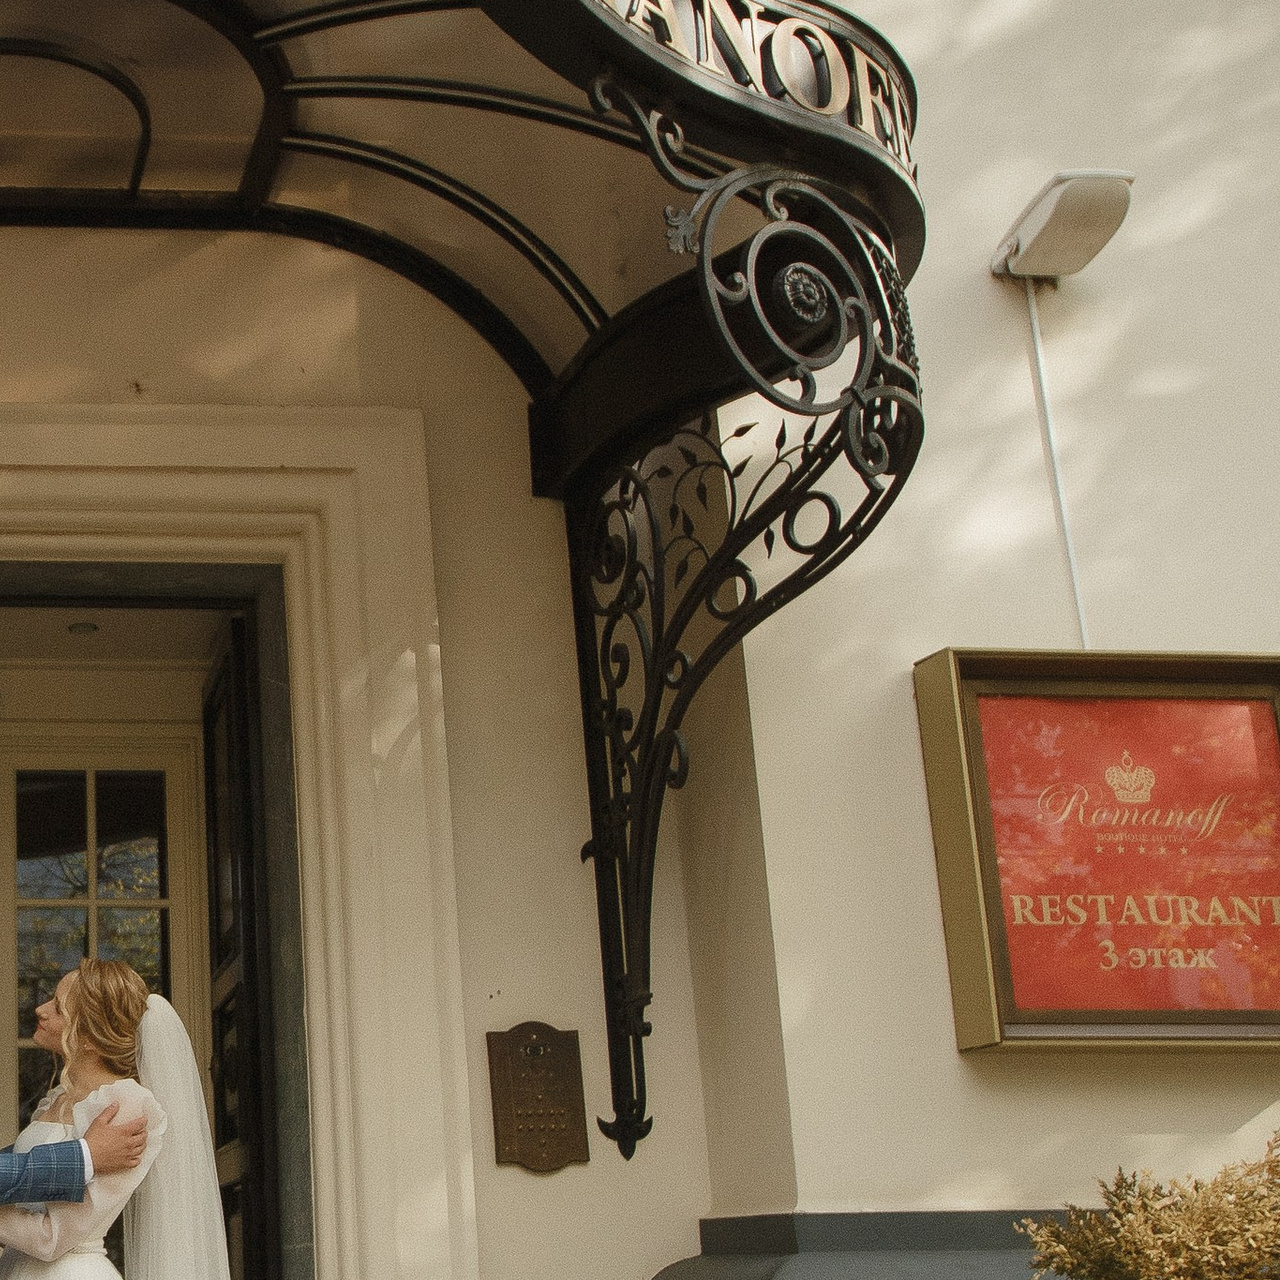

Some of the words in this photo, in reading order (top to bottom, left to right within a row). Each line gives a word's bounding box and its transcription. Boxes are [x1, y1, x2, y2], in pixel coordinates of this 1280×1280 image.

[1035, 780, 1235, 843] Romanoff
[1010, 893, 1280, 927] RESTAURANT
[1098, 938, 1119, 971] 3
[1128, 942, 1219, 970] этаж
